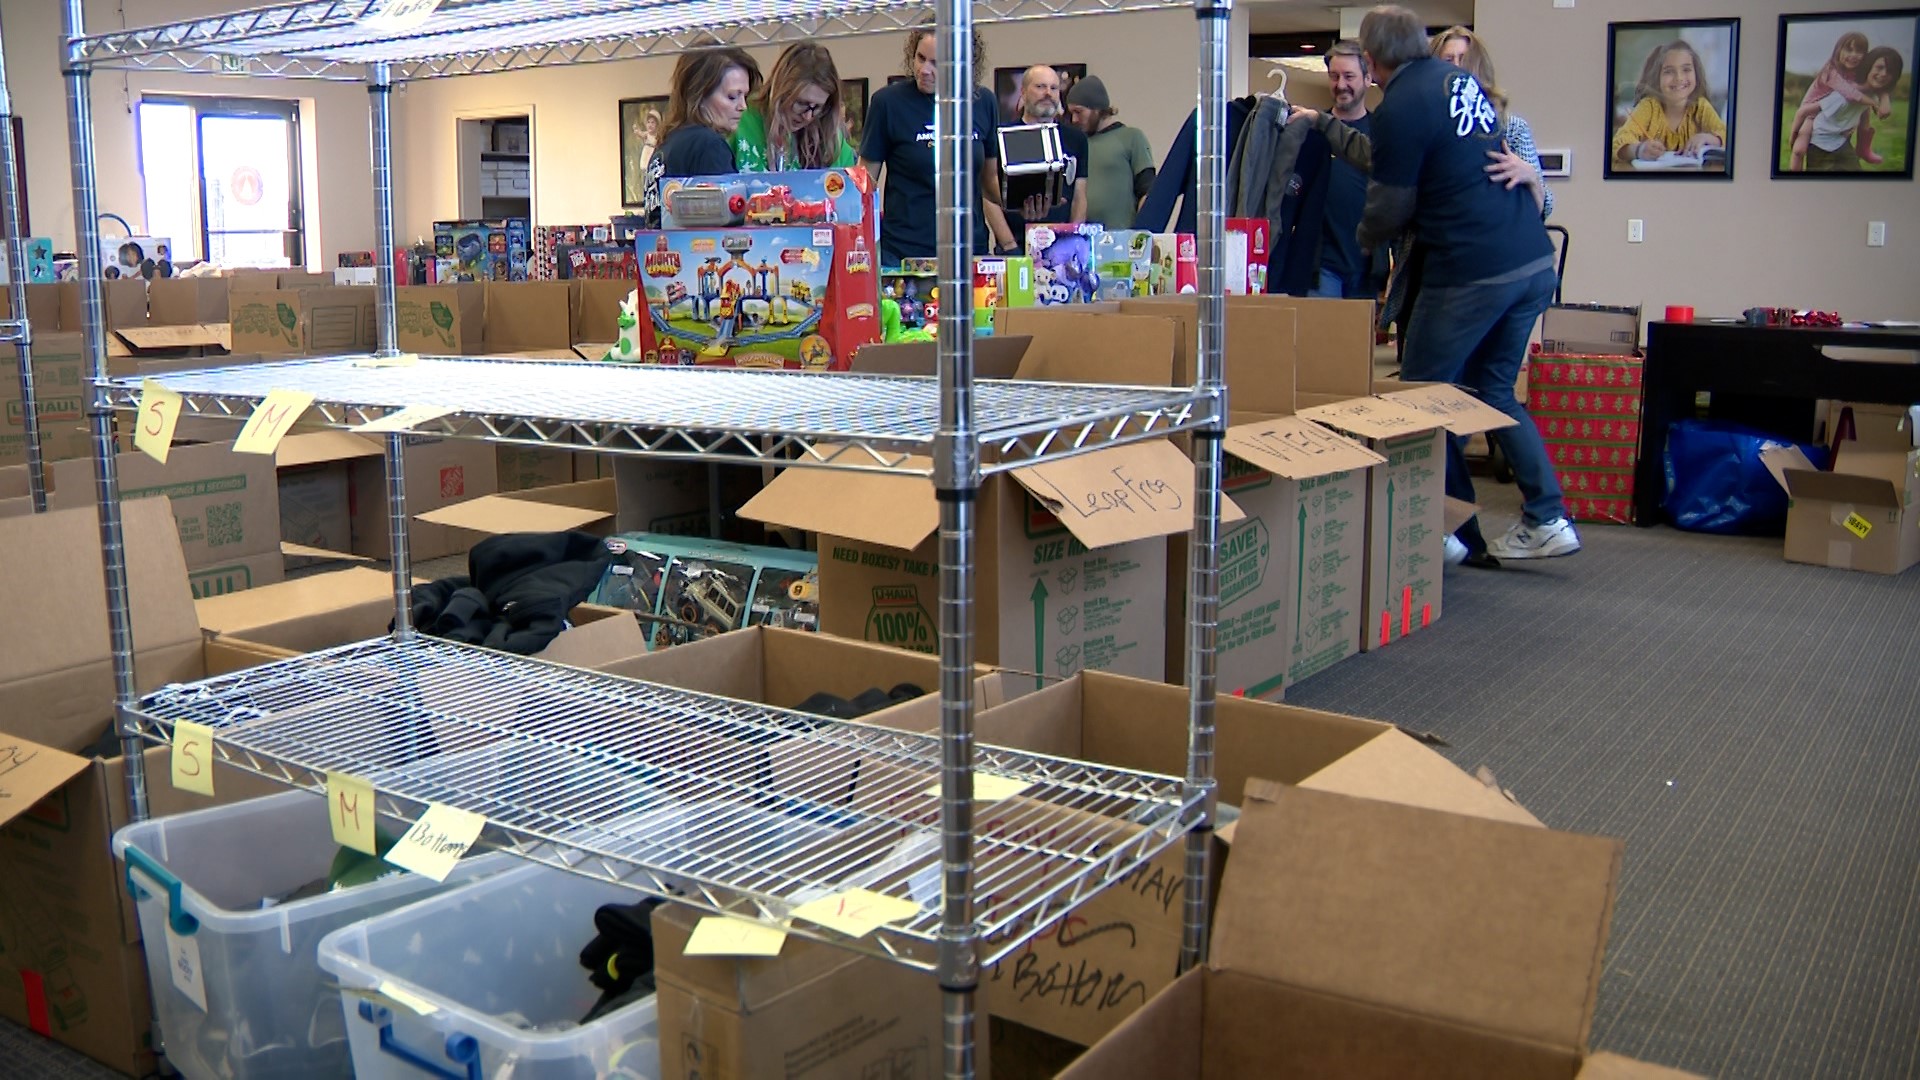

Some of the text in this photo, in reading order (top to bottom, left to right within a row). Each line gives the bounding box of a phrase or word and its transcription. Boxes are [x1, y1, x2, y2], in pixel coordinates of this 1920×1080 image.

[145, 401, 165, 436] S
[251, 404, 291, 438] M
[833, 546, 859, 563] NEED
[861, 551, 900, 570] BOXES?
[904, 559, 929, 576] TAKE
[1033, 540, 1064, 565] SIZE
[1220, 525, 1257, 564] SAVE!
[1220, 554, 1258, 588] BEST PRICE
[875, 589, 914, 600] U-HAUL
[873, 611, 927, 642] 100%
[179, 741, 200, 776] S
[340, 791, 360, 831] M
